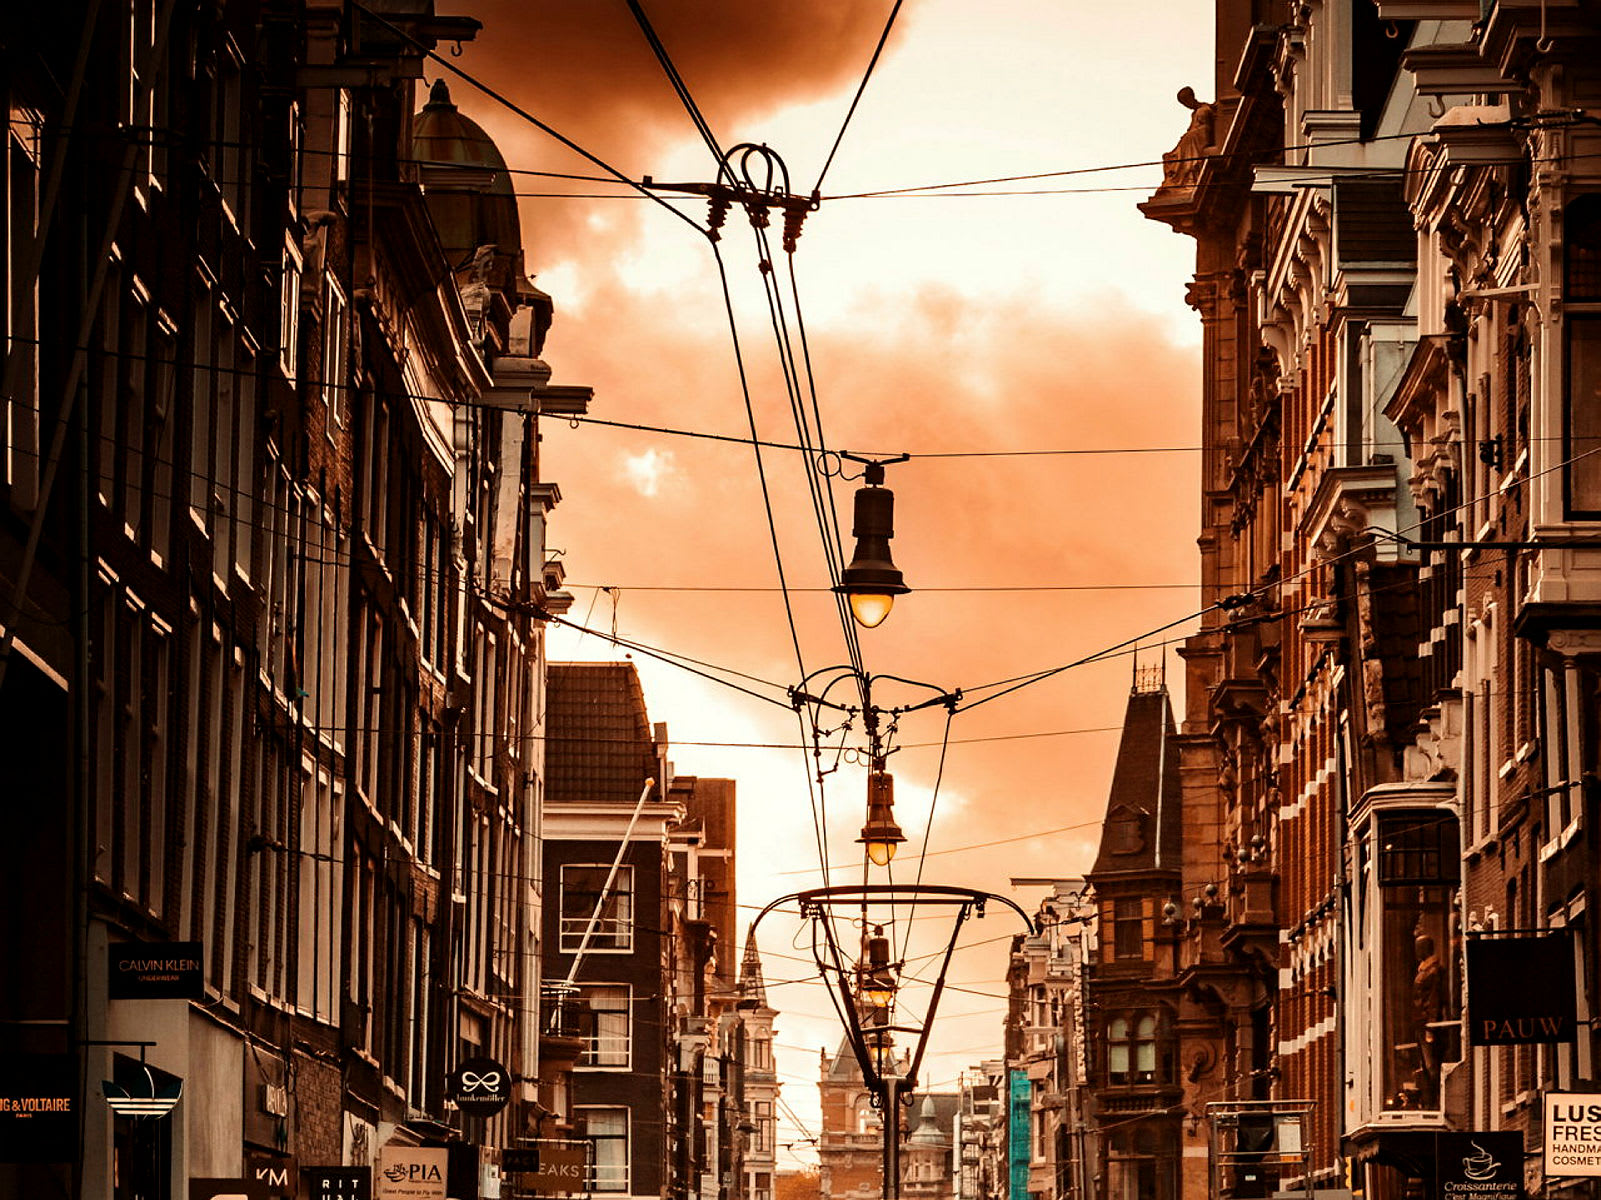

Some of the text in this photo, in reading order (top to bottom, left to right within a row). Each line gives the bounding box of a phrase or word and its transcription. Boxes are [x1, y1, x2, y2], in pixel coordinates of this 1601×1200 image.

[119, 959, 200, 972] CALVIN KLEIN
[1482, 1016, 1564, 1040] PAUW
[1553, 1104, 1601, 1123] LUS
[409, 1164, 442, 1181] PIA
[1443, 1181, 1518, 1192] Croissanterie
